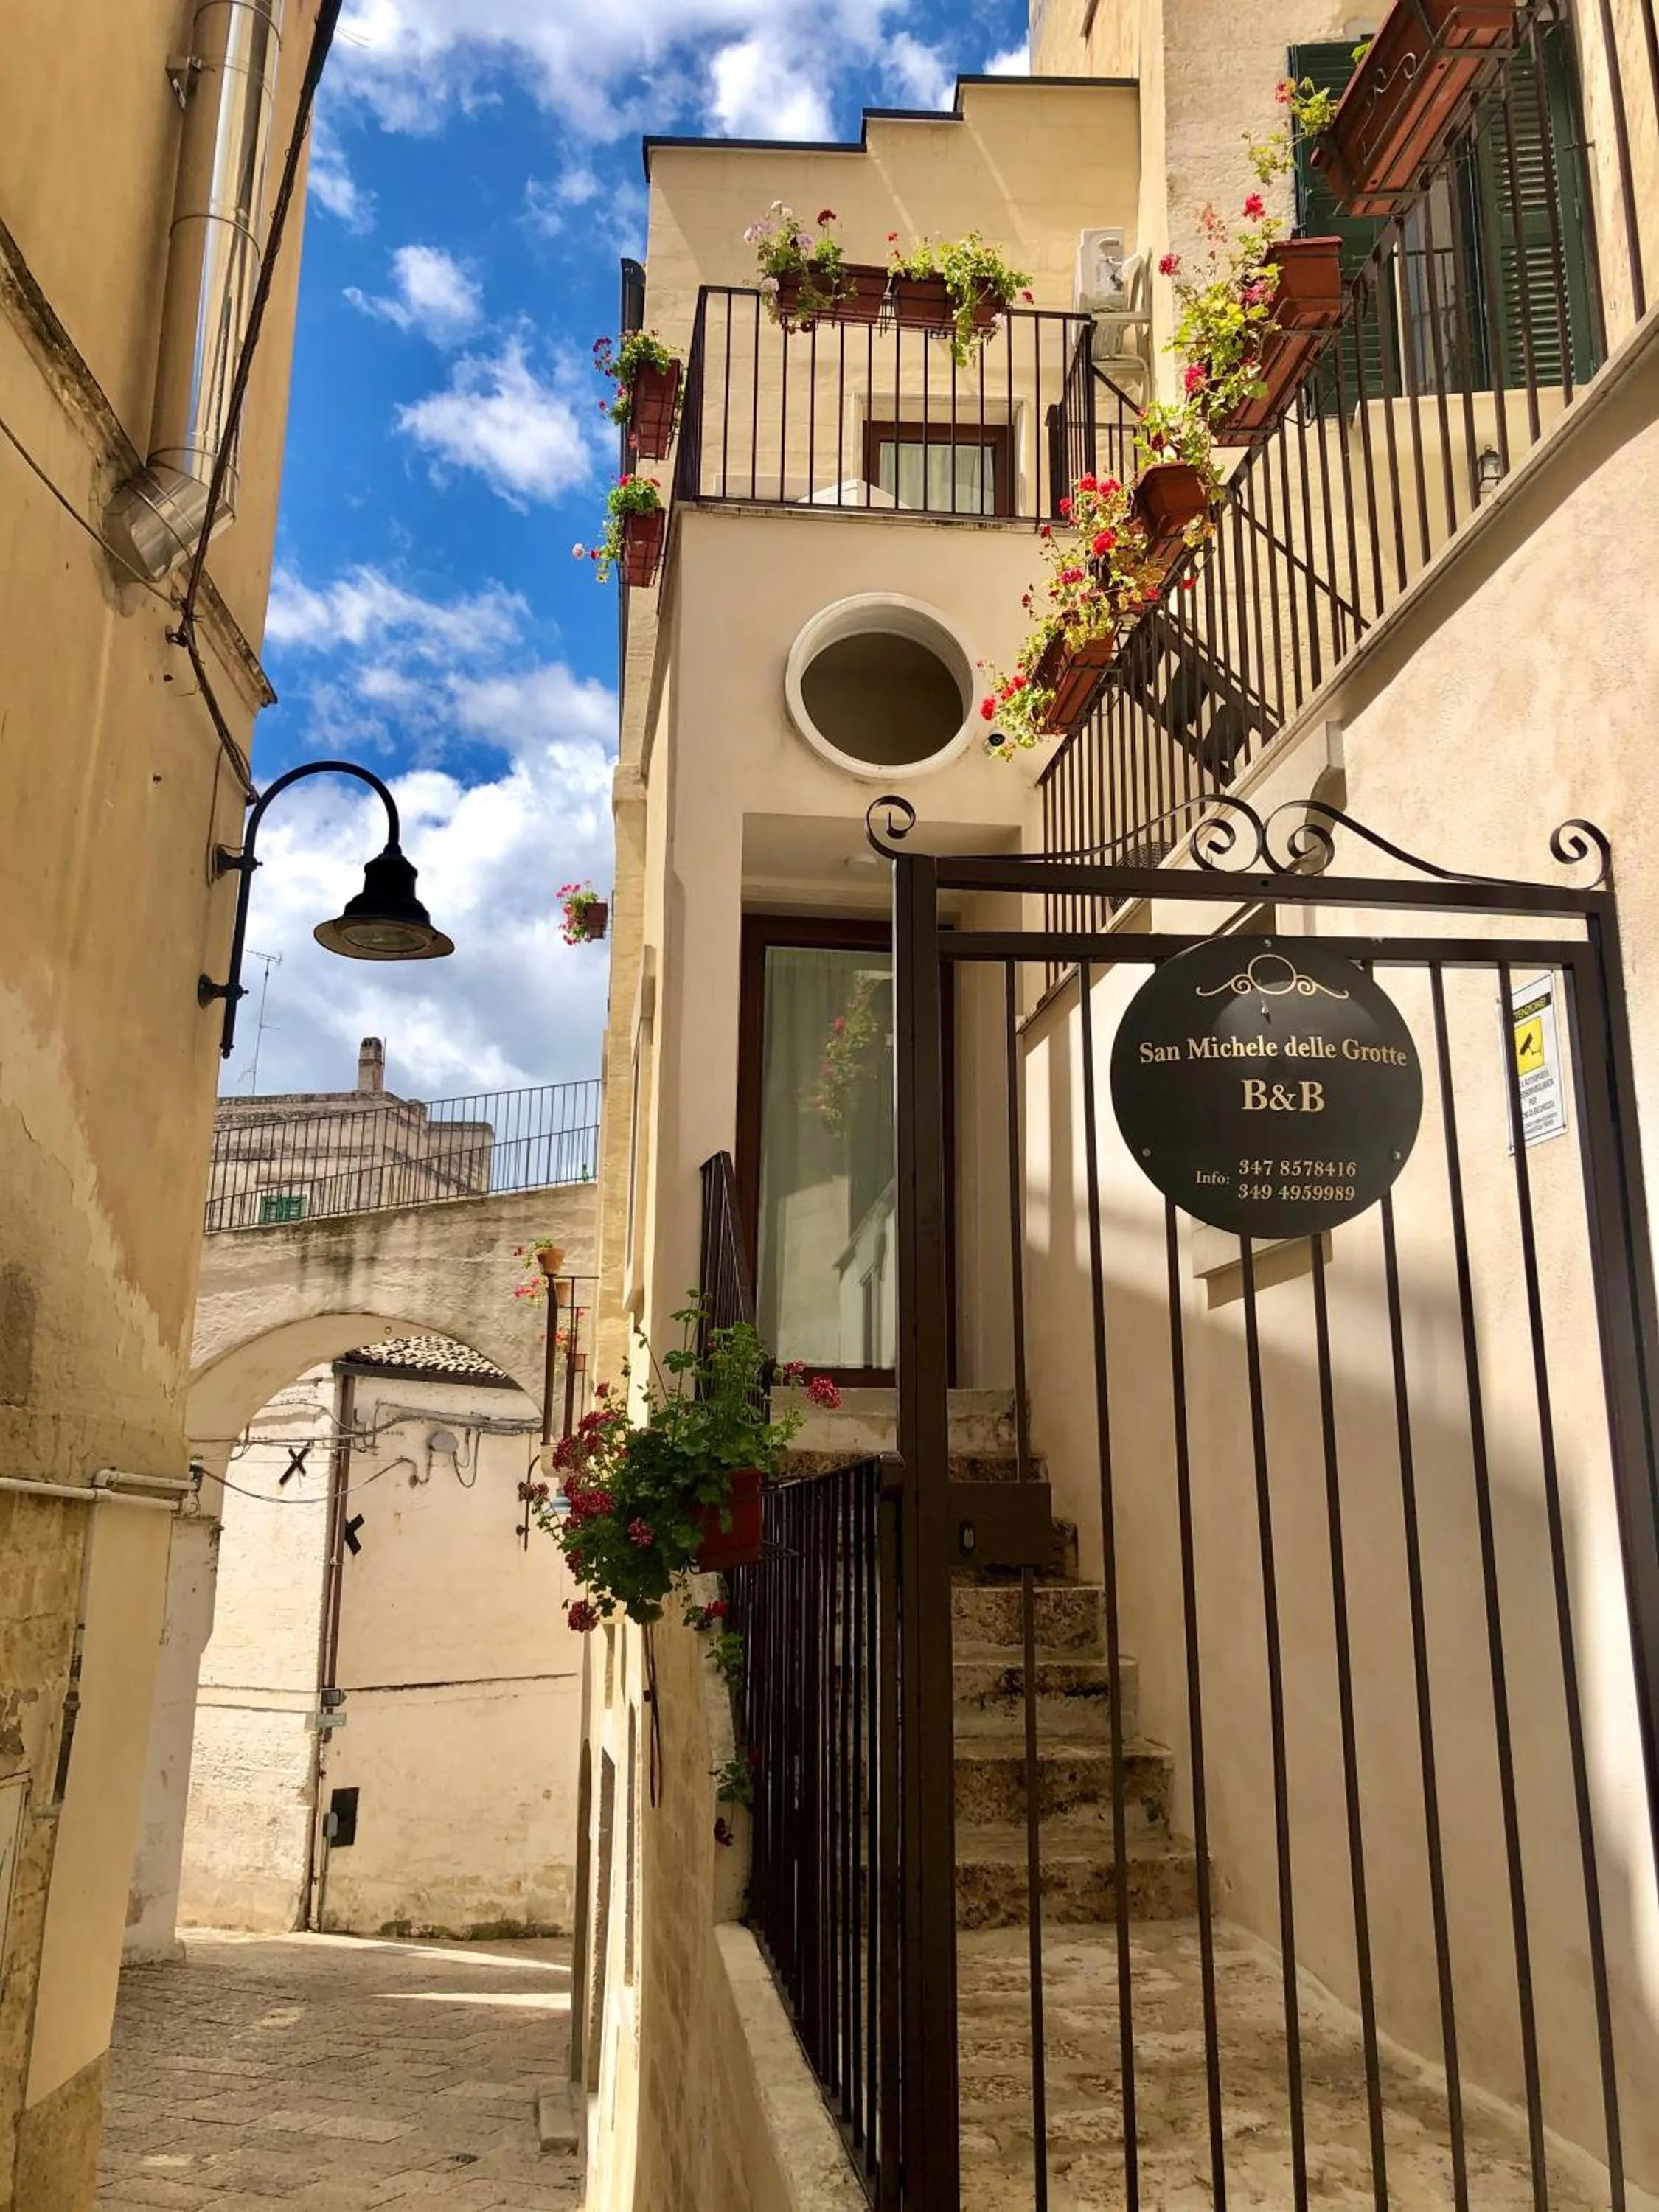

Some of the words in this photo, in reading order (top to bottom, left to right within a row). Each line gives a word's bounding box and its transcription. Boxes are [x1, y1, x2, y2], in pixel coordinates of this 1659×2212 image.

[1139, 1042, 1180, 1064] San
[1187, 1034, 1278, 1060] Michele
[1284, 1035, 1336, 1059] delle
[1342, 1039, 1407, 1067] Grotte
[1242, 1079, 1325, 1113] B&B
[1196, 1170, 1230, 1185] Info:
[1239, 1159, 1273, 1176] 347
[1279, 1160, 1357, 1178] 8578416
[1238, 1184, 1273, 1200] 349
[1278, 1185, 1355, 1201] 4959989
